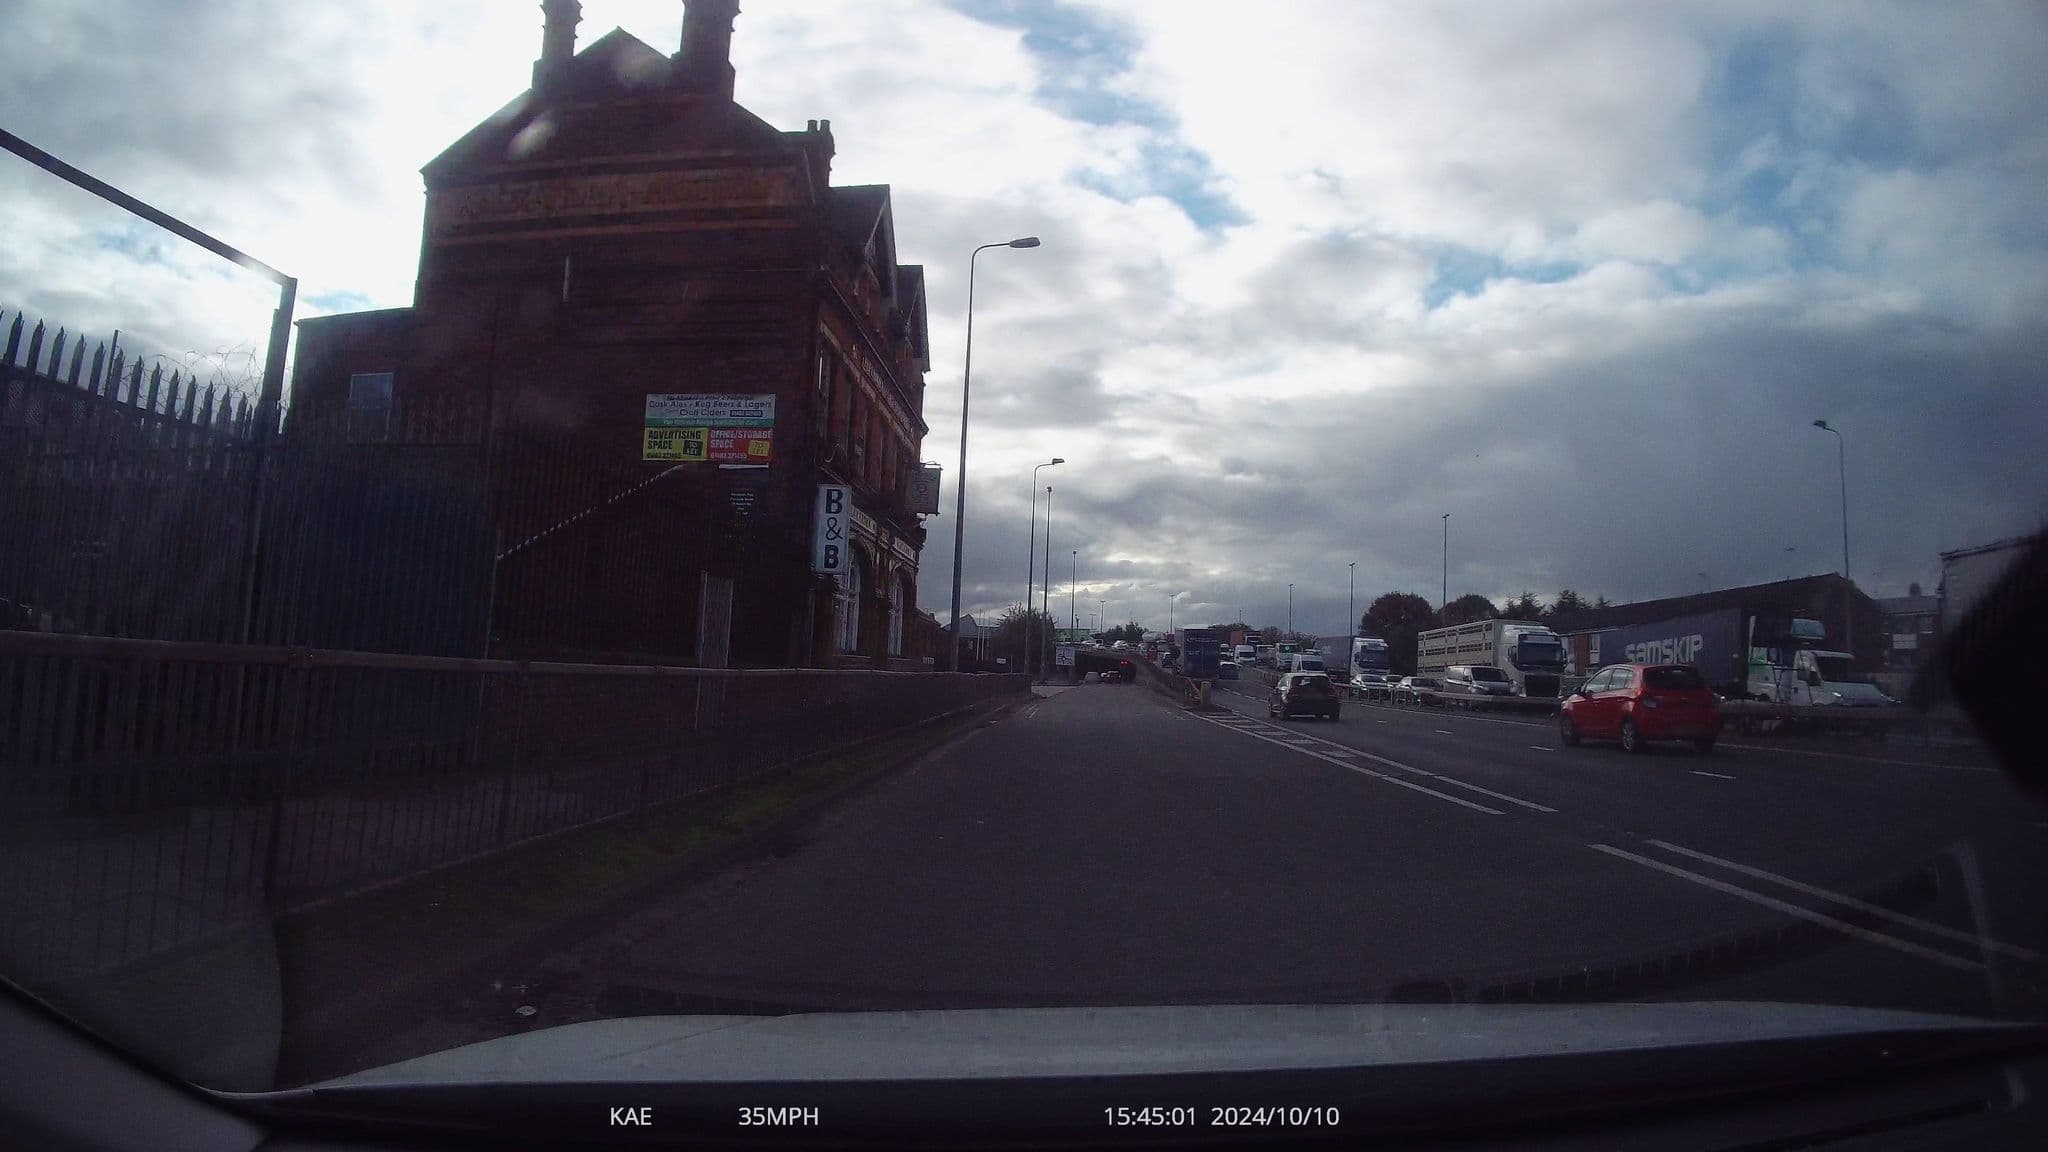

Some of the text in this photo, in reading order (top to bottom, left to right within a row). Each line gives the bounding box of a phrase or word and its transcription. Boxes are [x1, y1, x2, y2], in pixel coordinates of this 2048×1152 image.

[671, 400, 687, 408] Ales
[695, 401, 711, 409] Keg
[713, 400, 734, 408] Beers
[745, 400, 772, 409] Lagers
[701, 409, 726, 417] Ciders
[648, 430, 701, 439] ADVERTISING
[647, 440, 673, 450] SPACE
[710, 439, 735, 448] SPACE
